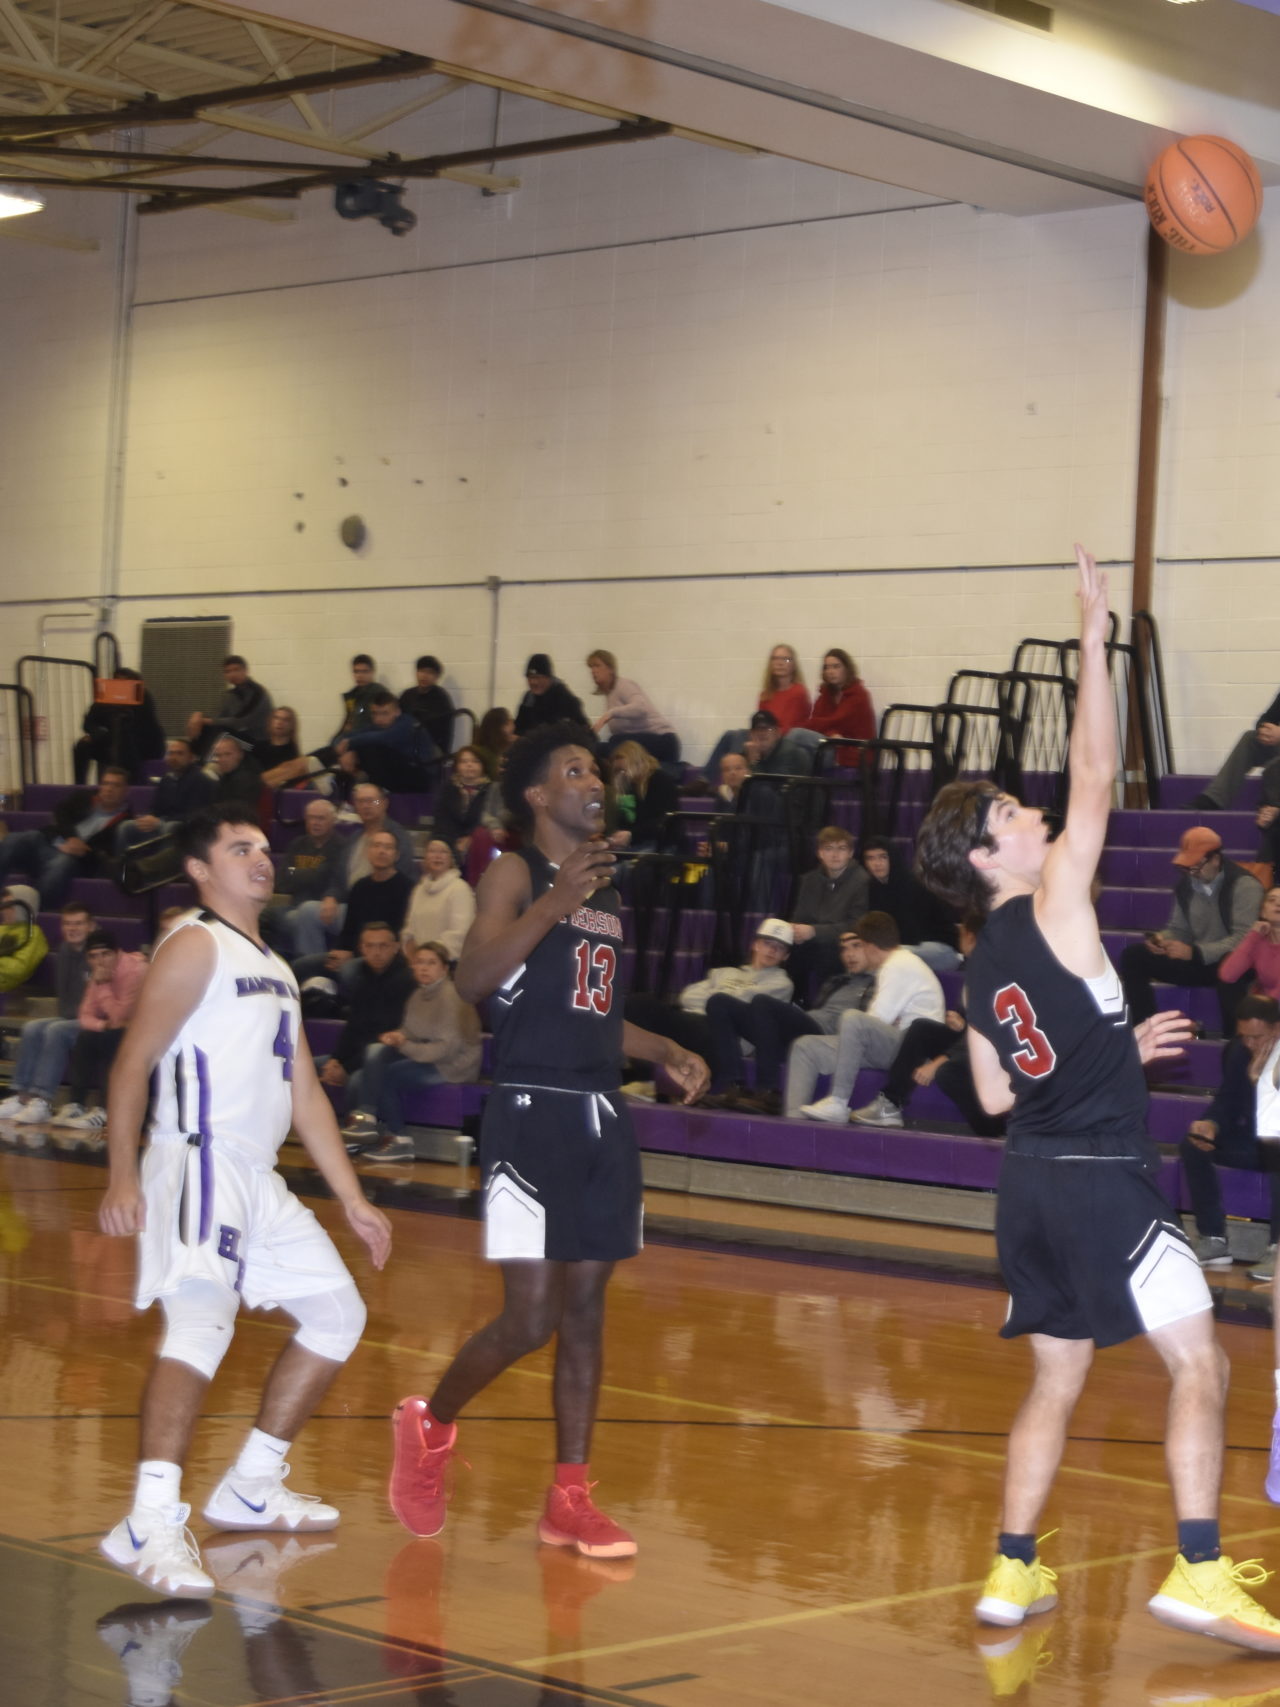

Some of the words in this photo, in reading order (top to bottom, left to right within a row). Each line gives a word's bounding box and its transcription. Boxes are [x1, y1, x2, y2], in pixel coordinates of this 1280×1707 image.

[560, 905, 624, 942] IERSON
[573, 938, 617, 1016] 13
[273, 1009, 295, 1082] 4
[993, 982, 1057, 1079] 3
